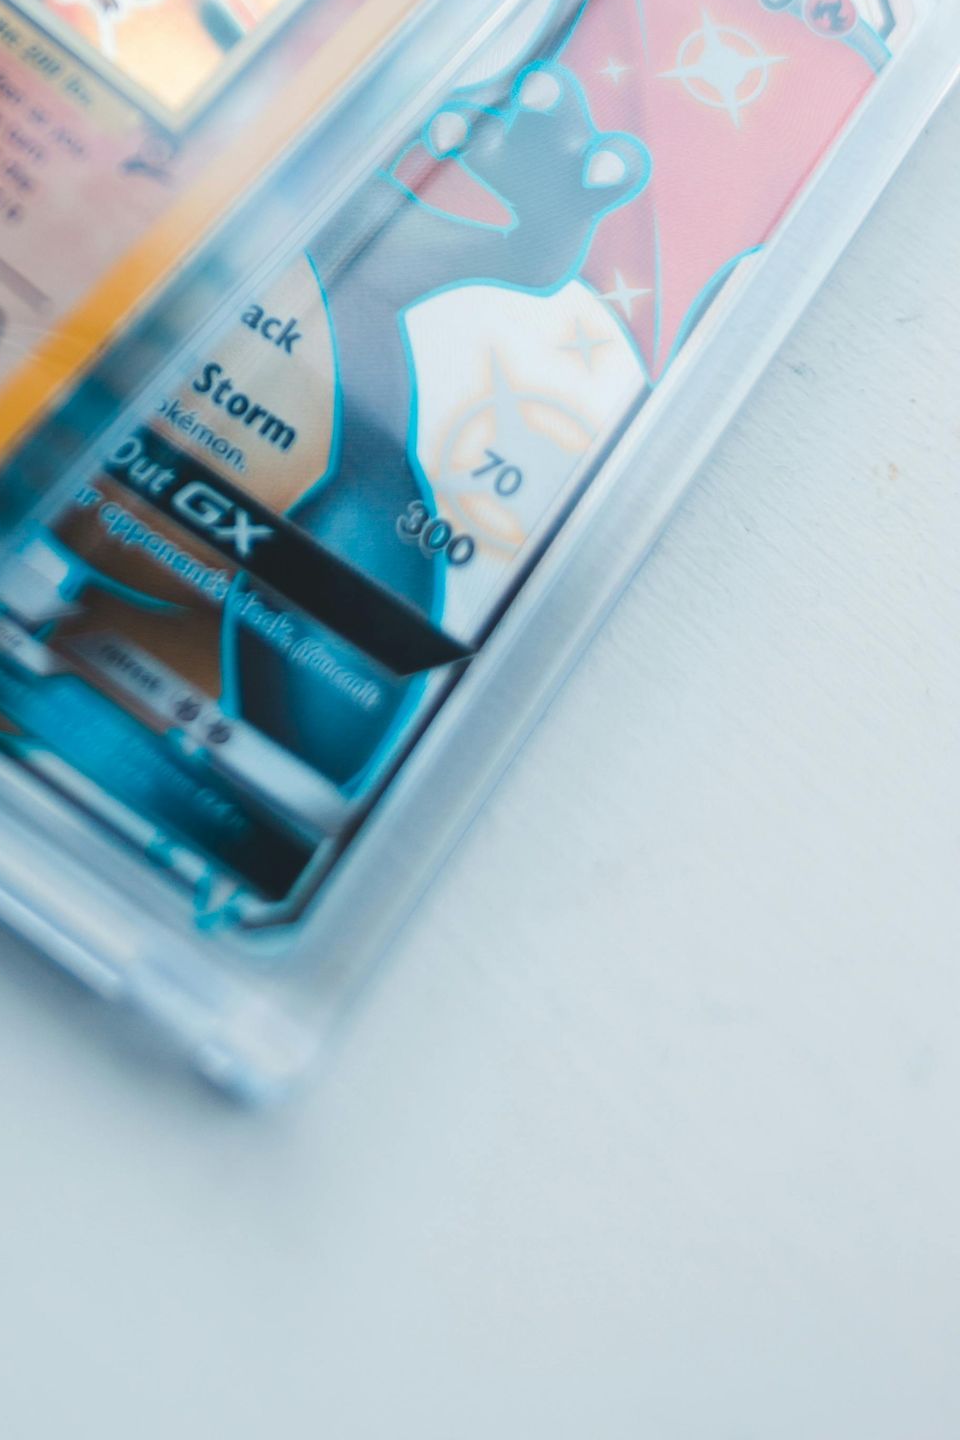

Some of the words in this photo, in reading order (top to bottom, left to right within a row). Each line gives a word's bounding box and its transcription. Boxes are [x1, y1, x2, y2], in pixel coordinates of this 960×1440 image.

[241, 303, 301, 355] ack
[191, 362, 298, 452] Storm
[471, 446, 523, 497] 70
[172, 481, 275, 557] GX
[396, 499, 475, 567] 300
